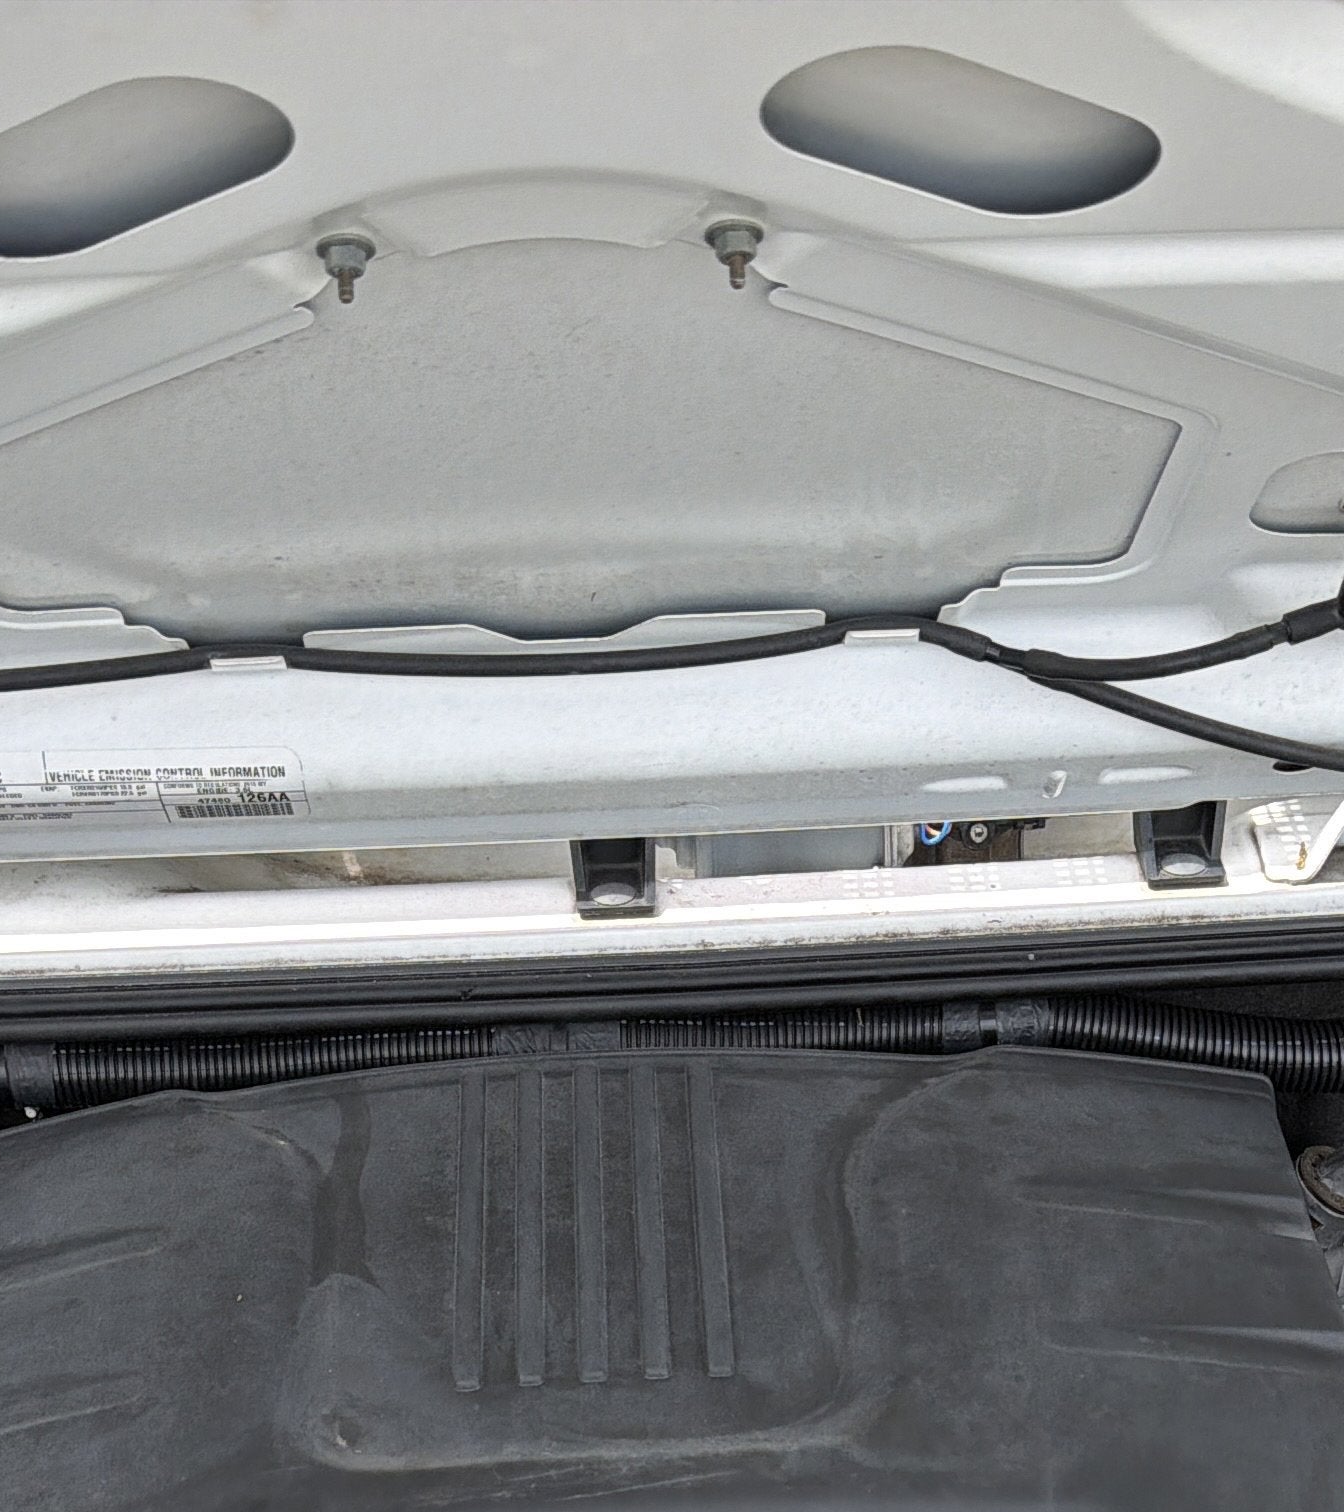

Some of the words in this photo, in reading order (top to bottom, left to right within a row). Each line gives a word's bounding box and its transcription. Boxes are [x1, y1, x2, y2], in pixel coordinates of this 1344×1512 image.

[49, 770, 96, 782] VEHICLE
[98, 768, 152, 780] EMISSION
[156, 767, 203, 779] CONTROL
[210, 766, 286, 777] INFORMATION
[239, 792, 290, 803] 126AA
